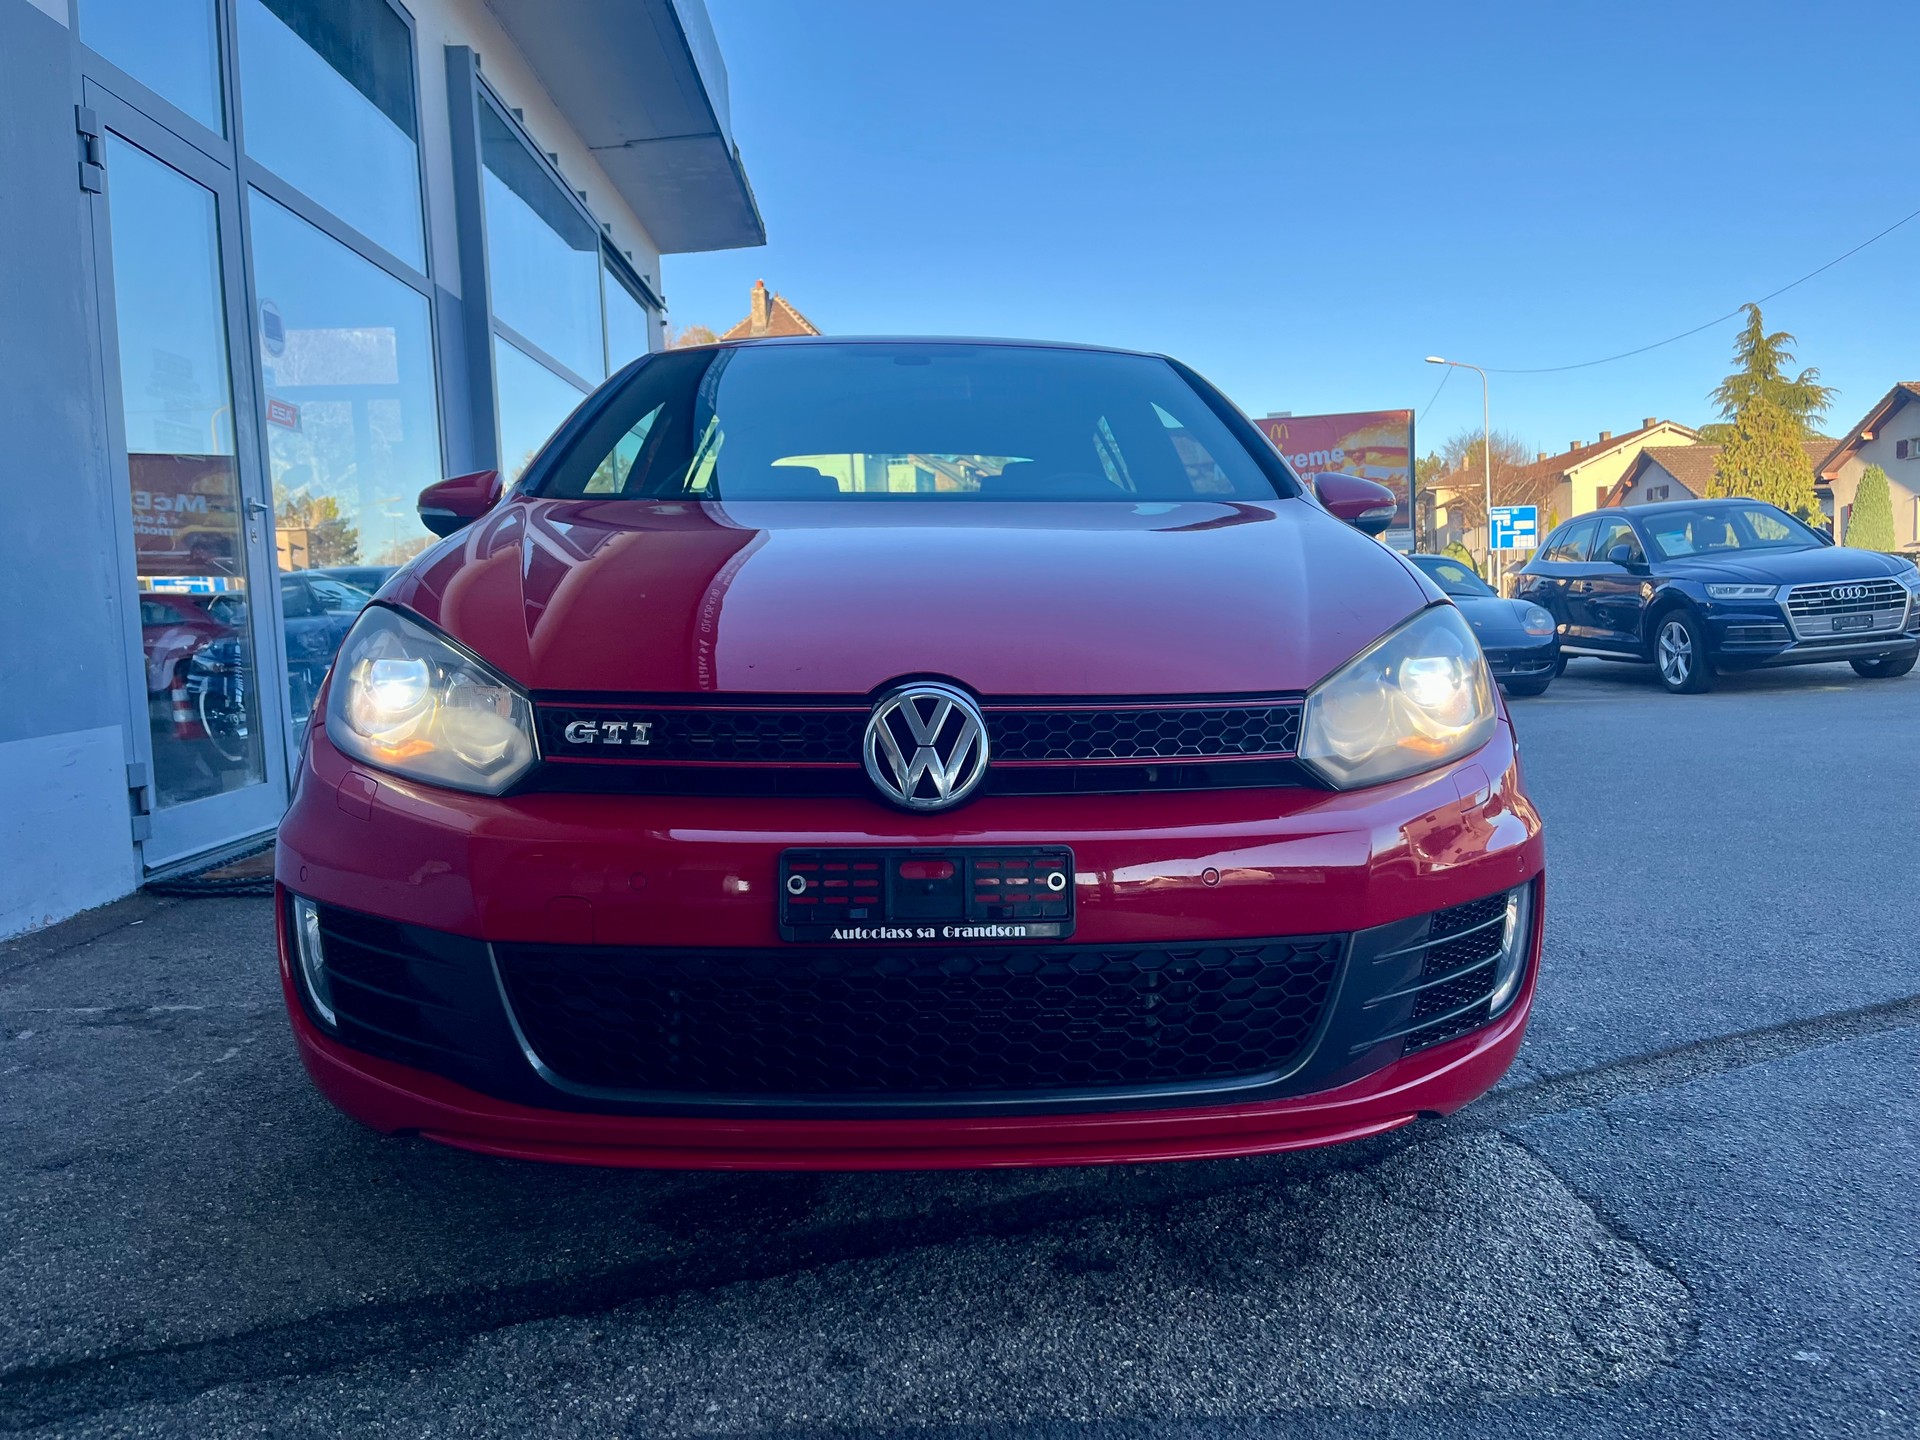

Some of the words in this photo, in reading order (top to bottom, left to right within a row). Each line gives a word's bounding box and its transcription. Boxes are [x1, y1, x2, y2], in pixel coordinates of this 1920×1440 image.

[564, 720, 653, 746] GTI
[830, 927, 913, 940] Autoclass
[916, 926, 936, 938] sa
[942, 924, 1026, 938] Grandson
